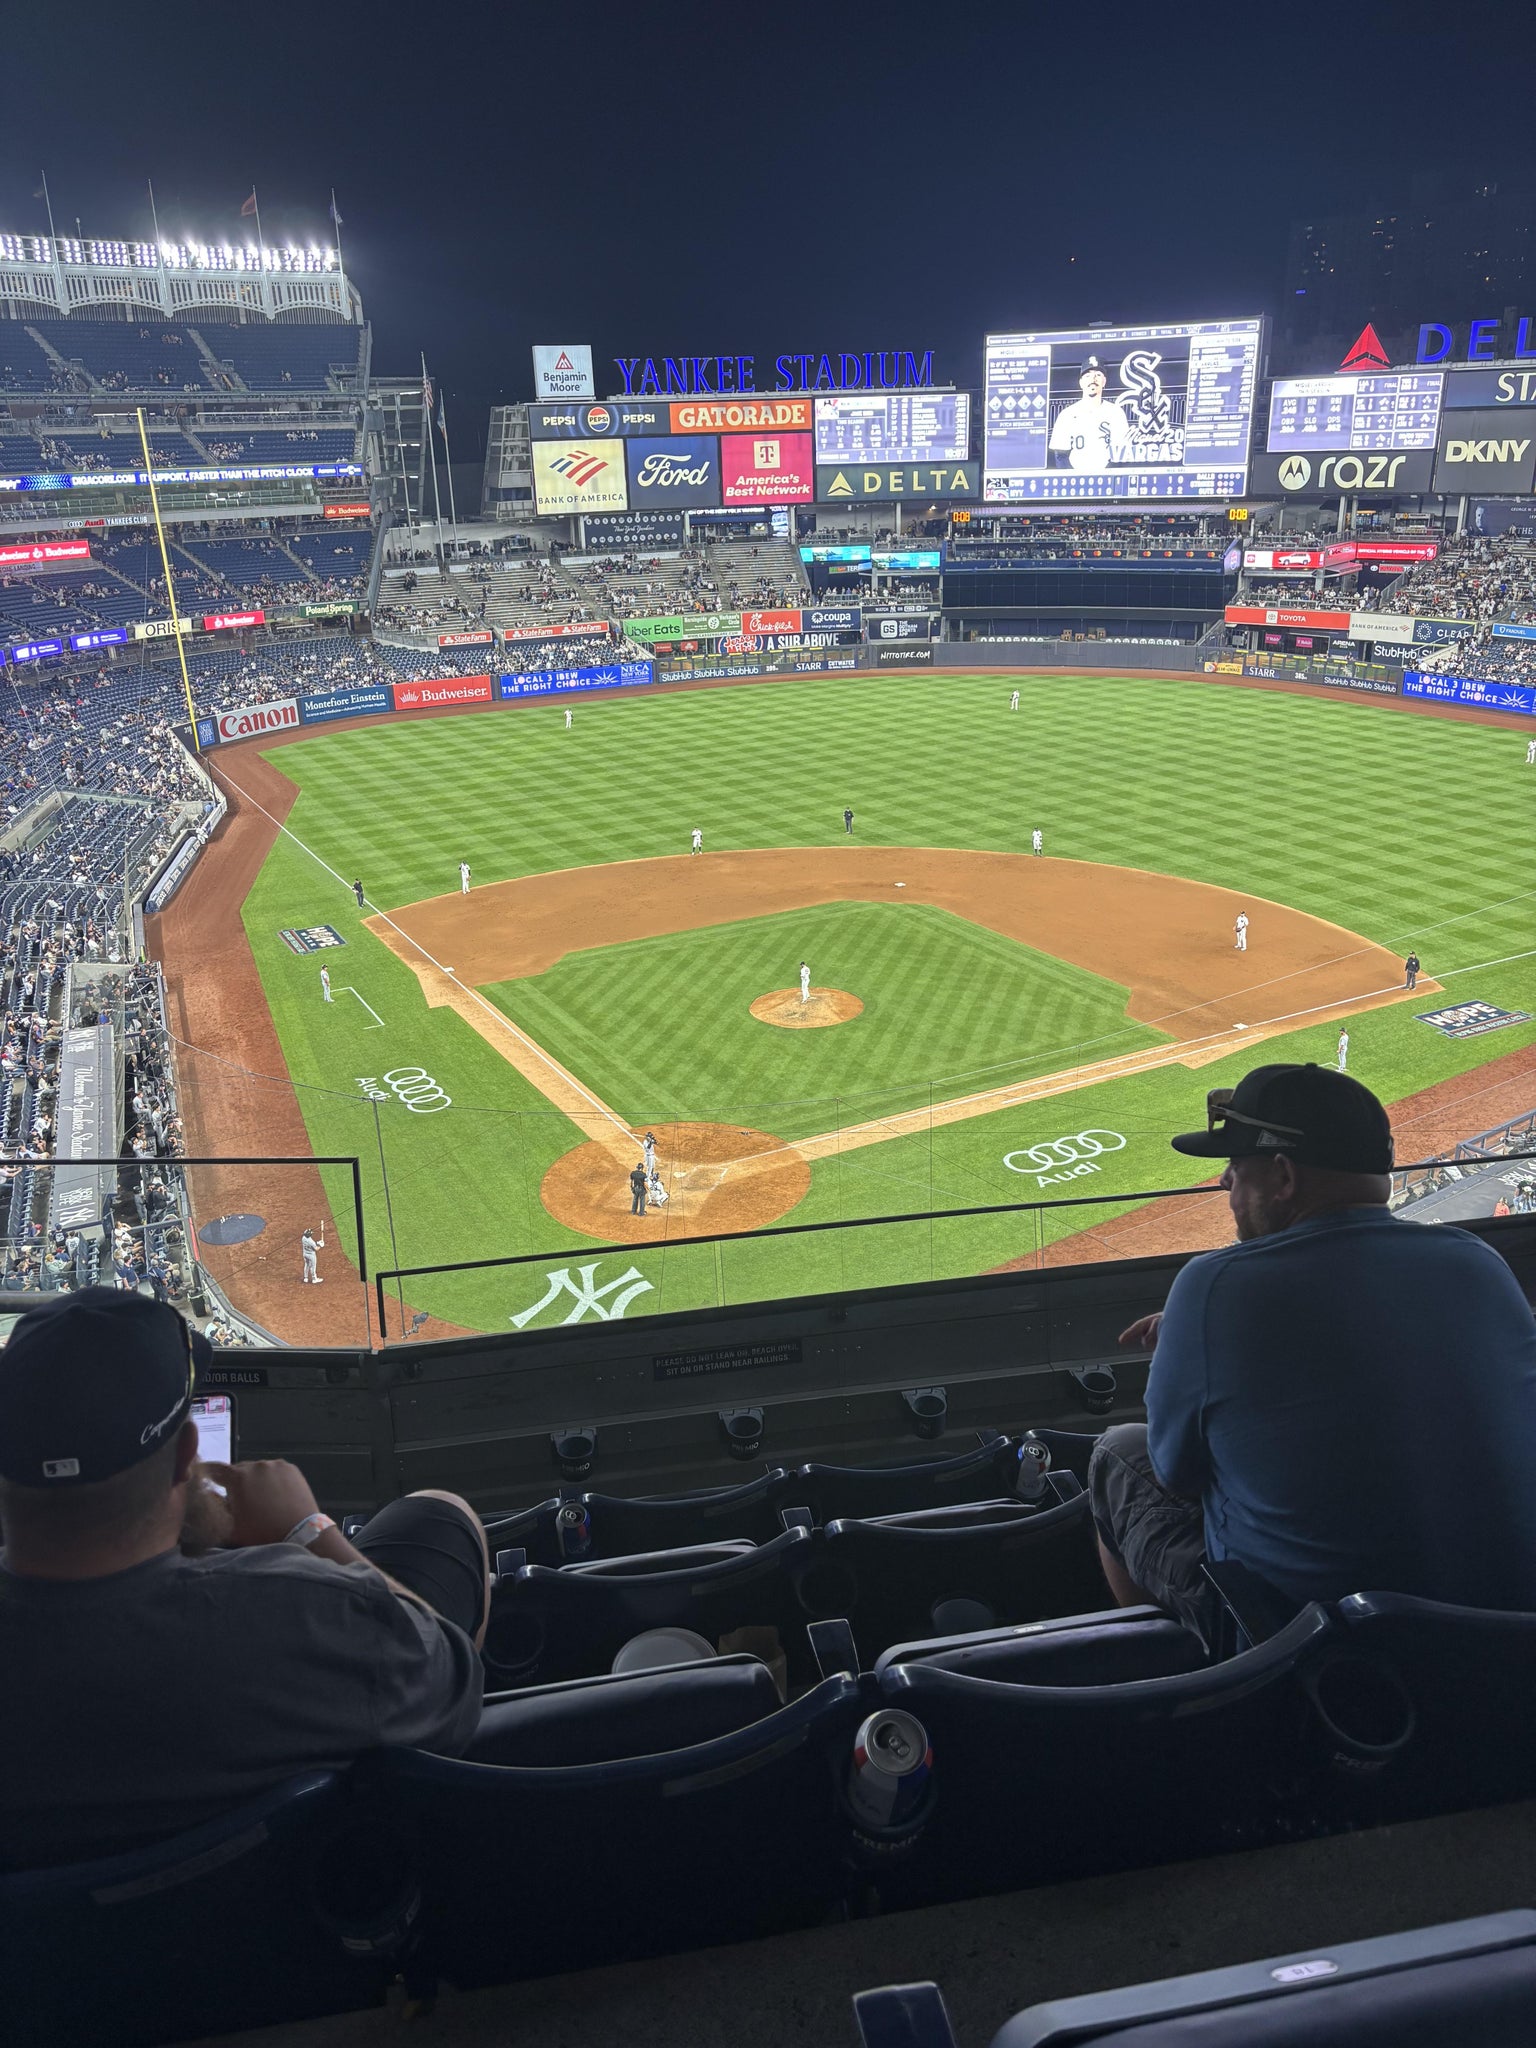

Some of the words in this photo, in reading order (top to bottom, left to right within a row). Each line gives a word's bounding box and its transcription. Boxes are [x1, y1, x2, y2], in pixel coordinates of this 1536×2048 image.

[543, 372, 587, 383] Benjamin
[613, 356, 756, 396] YANKEE
[776, 350, 935, 391] STADIUM
[550, 383, 580, 392] Moore
[1495, 372, 1536, 402] ST
[543, 415, 576, 426] PEPSI
[589, 416, 609, 424] PEPSI
[622, 413, 656, 424] PEPSI
[678, 404, 806, 429] GATORADE
[1165, 428, 1185, 443] 20
[1110, 442, 1183, 463] VARGAS
[1445, 439, 1531, 462] DKNY
[152, 471, 189, 483] UPPORT,
[189, 470, 219, 480] FASTER
[221, 469, 243, 479] THAN
[244, 468, 261, 478] THE
[260, 468, 285, 478] PITCH
[286, 466, 314, 477] CLOCK
[637, 453, 711, 487] Ford
[1318, 455, 1406, 488] razr
[735, 473, 800, 486] America's
[863, 469, 970, 493] DELTA
[726, 483, 753, 497] Best
[756, 485, 811, 496] Network
[538, 496, 564, 505] BANK
[566, 495, 579, 503] OF
[581, 493, 624, 503] AMERICA
[84, 519, 105, 527] Audi
[106, 517, 133, 525] YANKEES
[1229, 508, 1248, 520] 0:08
[45, 547, 87, 557] Budweiser
[305, 604, 330, 617] Poland
[330, 602, 354, 615] Spring
[224, 616, 255, 626] Budweiser
[823, 612, 852, 625] coupa
[145, 621, 181, 637] ORIS
[625, 625, 651, 637] Uber
[653, 624, 681, 635] Eats
[883, 625, 895, 634] GS
[767, 636, 774, 650] A
[778, 634, 800, 649] SUB
[804, 633, 839, 648] ABOVE
[880, 650, 931, 660] NITTOTIRE.COM
[1374, 645, 1417, 660] StubHub
[621, 664, 649, 673] NECA
[796, 662, 822, 671] STARR
[828, 659, 855, 667] CUTWATER
[514, 676, 543, 685] LOCAL
[547, 674, 553, 682] 3
[556, 671, 579, 681] IBEW
[662, 672, 691, 682] StubHub
[694, 669, 725, 679] StubHub
[727, 666, 759, 677] StubHub
[1249, 666, 1275, 678] STARR
[502, 686, 519, 694] THE
[523, 683, 551, 692] RIGHT
[556, 678, 591, 688] CHOICE
[1324, 676, 1349, 686] StubHub
[1350, 679, 1372, 690] StubHub
[1374, 683, 1397, 693] StubHub
[1419, 675, 1448, 687] LOCAL
[1453, 681, 1458, 689] 3
[1462, 681, 1486, 692] IBEW
[305, 697, 349, 711] Montefiore
[351, 691, 385, 703] Einstein
[421, 686, 488, 702] Budweiser
[1406, 683, 1423, 692] THE
[1426, 685, 1456, 697] RIGHT
[1460, 690, 1498, 704] CHOICE
[219, 704, 298, 739] Canon
[73, 1066, 94, 1096] Welcome
[355, 1077, 392, 1101] Audi
[61, 1101, 95, 1131] Yankee
[70, 1131, 94, 1159] Stadiu
[1036, 1161, 1102, 1188] Audi
[656, 1357, 684, 1368] PLEASE
[686, 1356, 697, 1365] DO
[698, 1354, 714, 1363] NOT
[715, 1351, 735, 1361] LEAN
[751, 1345, 776, 1355] REACH
[666, 1367, 679, 1376] SIT
[680, 1366, 691, 1375] ON
[693, 1364, 704, 1373] OR
[705, 1361, 730, 1371] STAND
[732, 1358, 752, 1368] NEAR
[753, 1353, 789, 1366] RAILINGS
[230, 1372, 260, 1384] BALLS
